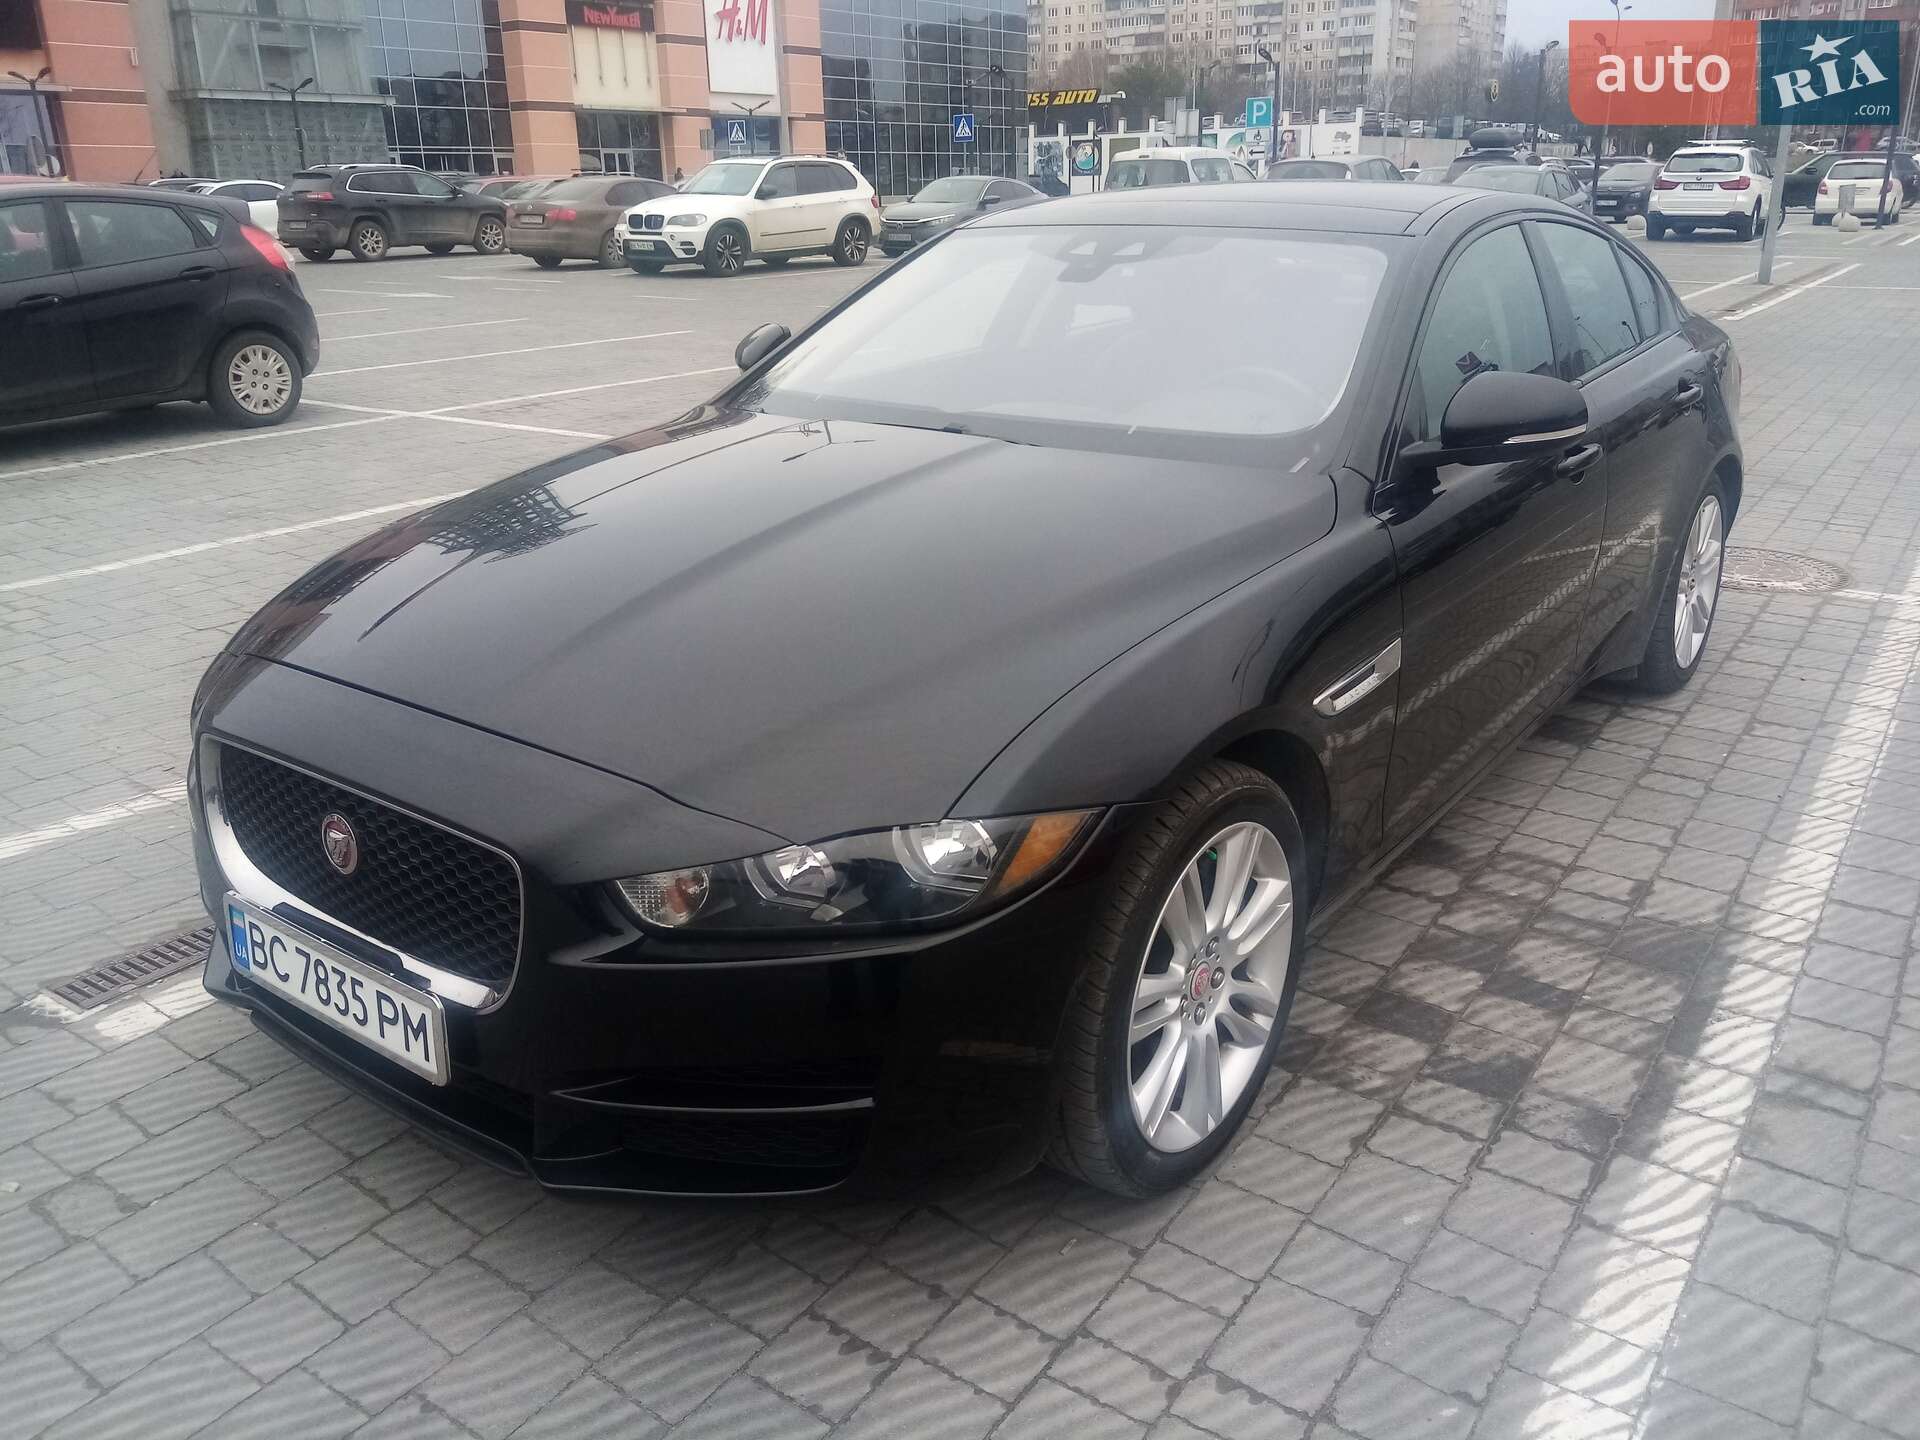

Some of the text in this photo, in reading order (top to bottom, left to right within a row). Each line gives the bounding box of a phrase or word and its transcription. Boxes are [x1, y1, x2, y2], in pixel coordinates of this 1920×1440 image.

[714, 0, 769, 46] H&M
[1052, 89, 1098, 105] AUTO
[1252, 100, 1267, 125] P
[234, 942, 248, 961] UA
[248, 920, 430, 1063] BC 7835 PM
